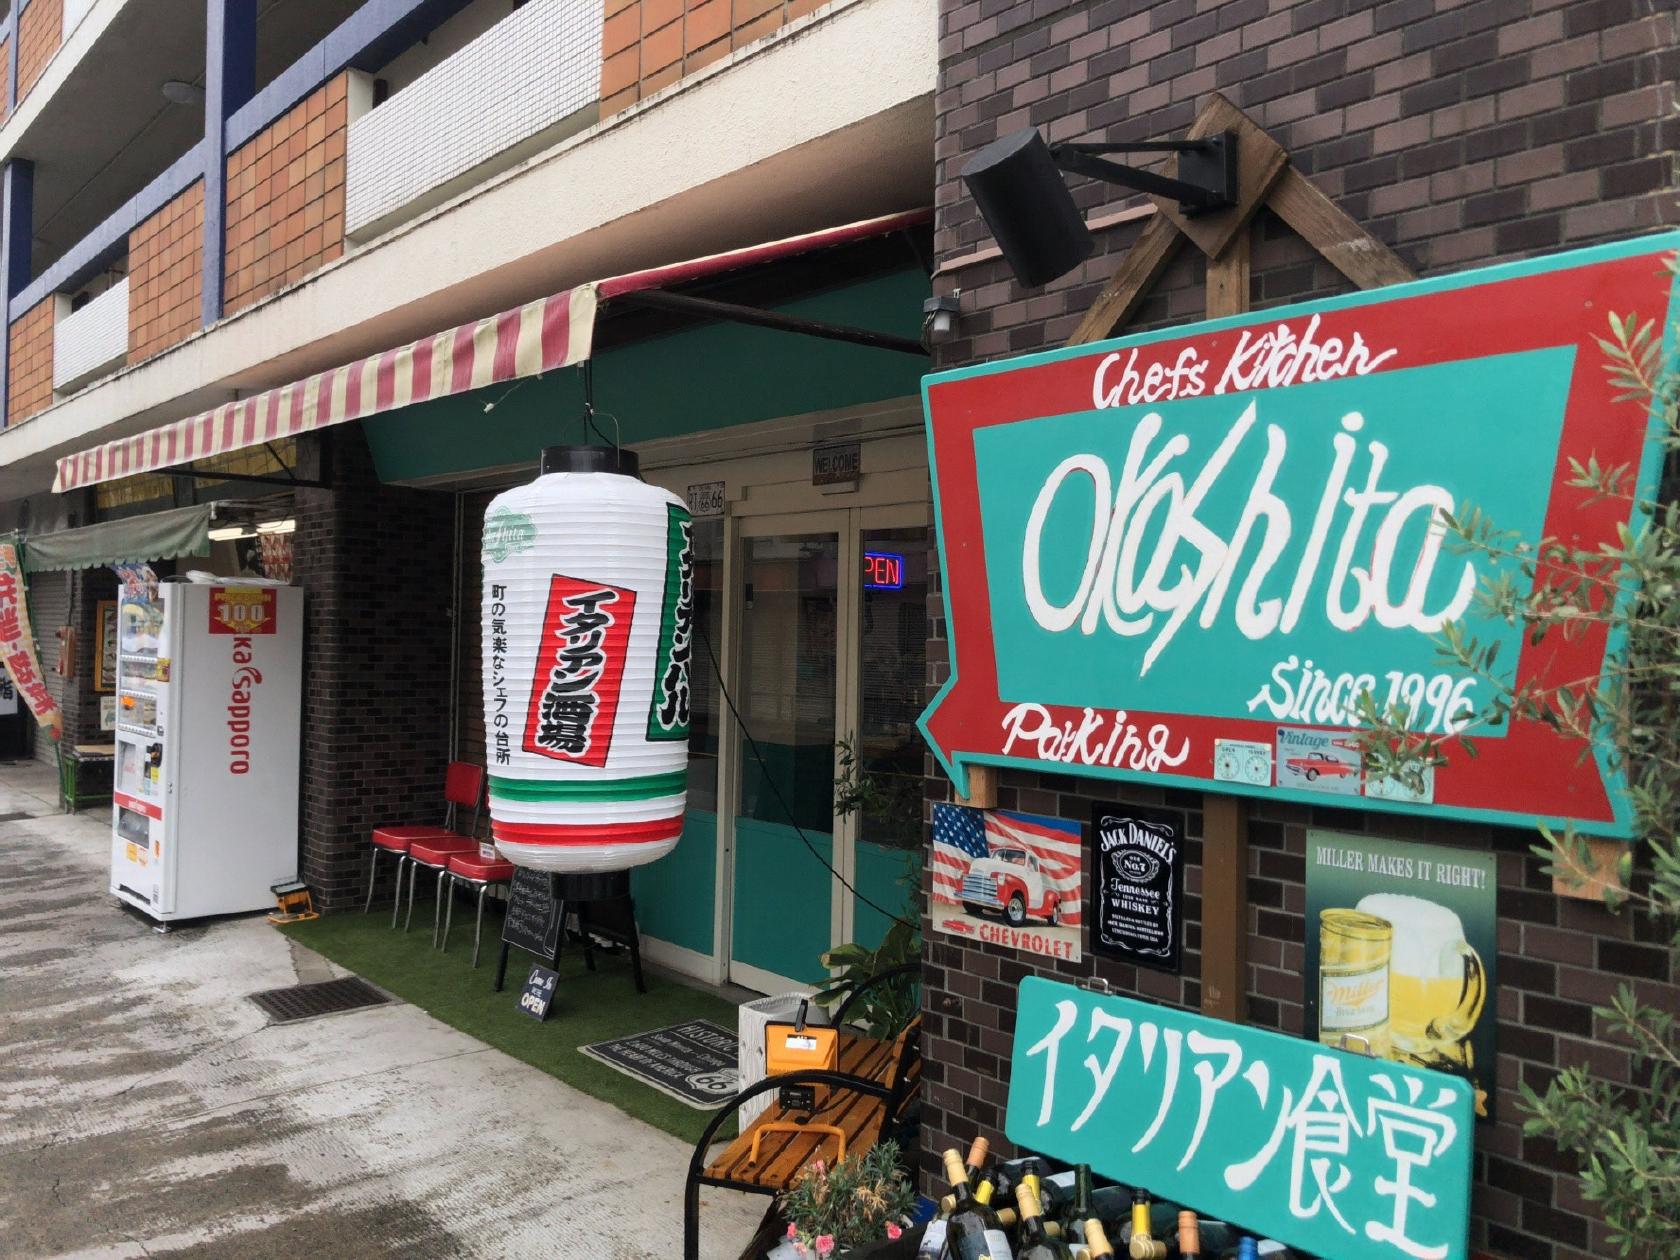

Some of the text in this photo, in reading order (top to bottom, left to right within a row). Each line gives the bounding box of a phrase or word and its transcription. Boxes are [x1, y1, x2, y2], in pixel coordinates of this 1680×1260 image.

[1214, 313, 1397, 395] Kitchen
[815, 453, 858, 474] WELCOME
[712, 490, 723, 508] 66
[864, 556, 899, 585] PEN
[217, 604, 263, 622] 100
[492, 584, 511, 766] 町の気楽なシェフの台所
[537, 588, 618, 755] イタリアン酒場
[1246, 655, 1477, 735] Since 1996
[227, 667, 262, 774] Sapporo
[1001, 703, 1190, 772] Parking
[1278, 729, 1329, 750] Vintage
[1100, 822, 1177, 865] JACK DANIEL'S
[1317, 846, 1486, 890] MILLER MAKES IT RIGHT!
[1111, 878, 1160, 899] Tennessee
[1111, 898, 1160, 915] WHISKEY
[979, 923, 1072, 959] CHEVROLET
[521, 992, 546, 1015] OPEN
[696, 1076, 734, 1090] 66
[1026, 1000, 1459, 1260] イタリアン食堂
